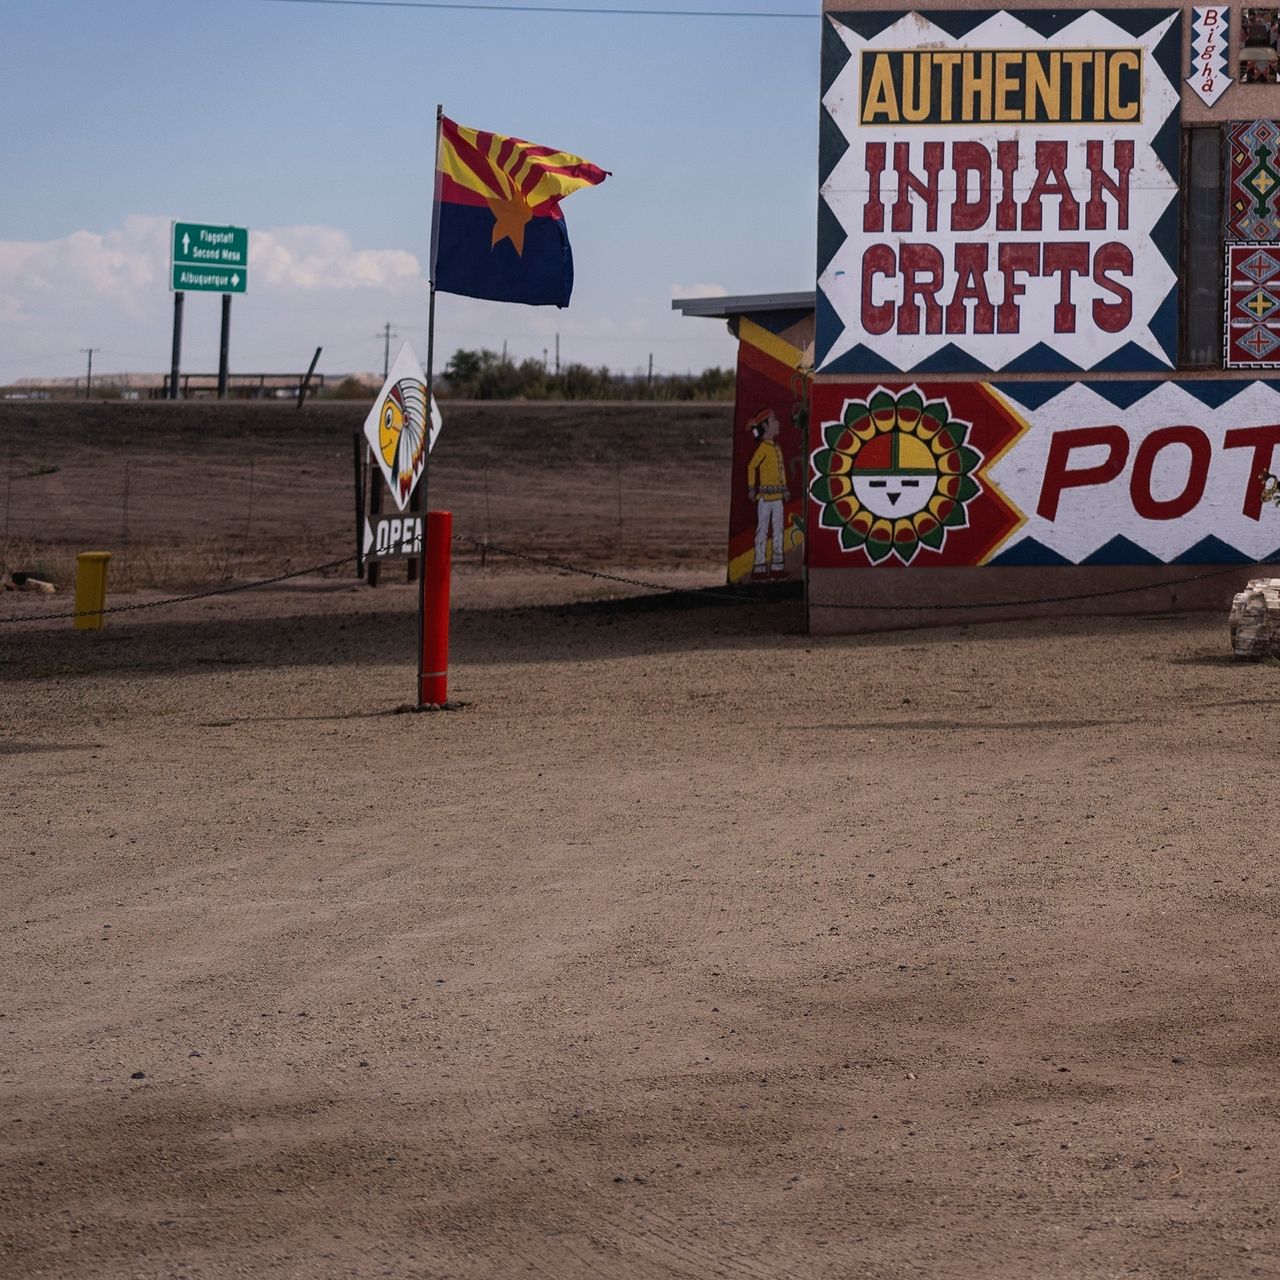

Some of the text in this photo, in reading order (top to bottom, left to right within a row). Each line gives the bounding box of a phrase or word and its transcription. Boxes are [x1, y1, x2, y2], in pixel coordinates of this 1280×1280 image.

[862, 51, 1139, 122] AUTHENTIC
[863, 140, 1135, 232] INDIAN
[193, 246, 240, 261] Second Mesa
[200, 230, 234, 245] Flagstaff
[180, 271, 229, 287] Albuquerque
[861, 241, 1134, 335] CRAFTS
